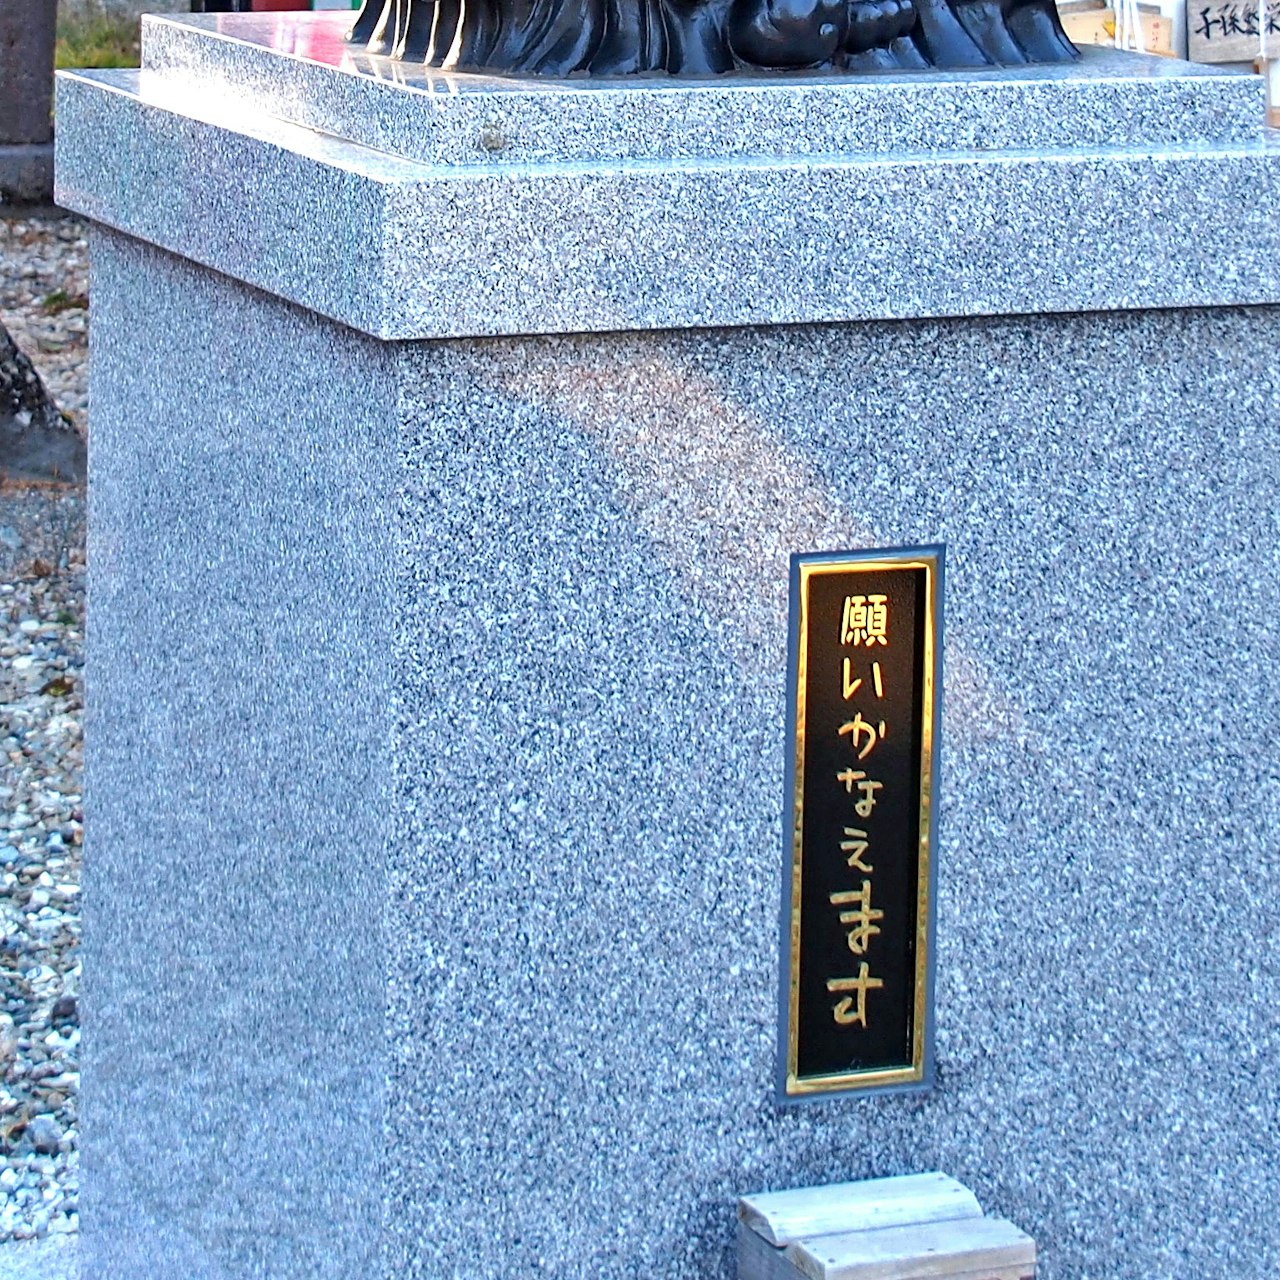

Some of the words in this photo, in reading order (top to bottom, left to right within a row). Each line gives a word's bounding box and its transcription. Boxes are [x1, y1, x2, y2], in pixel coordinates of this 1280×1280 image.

[826, 593, 891, 1029] 願いかなえます
